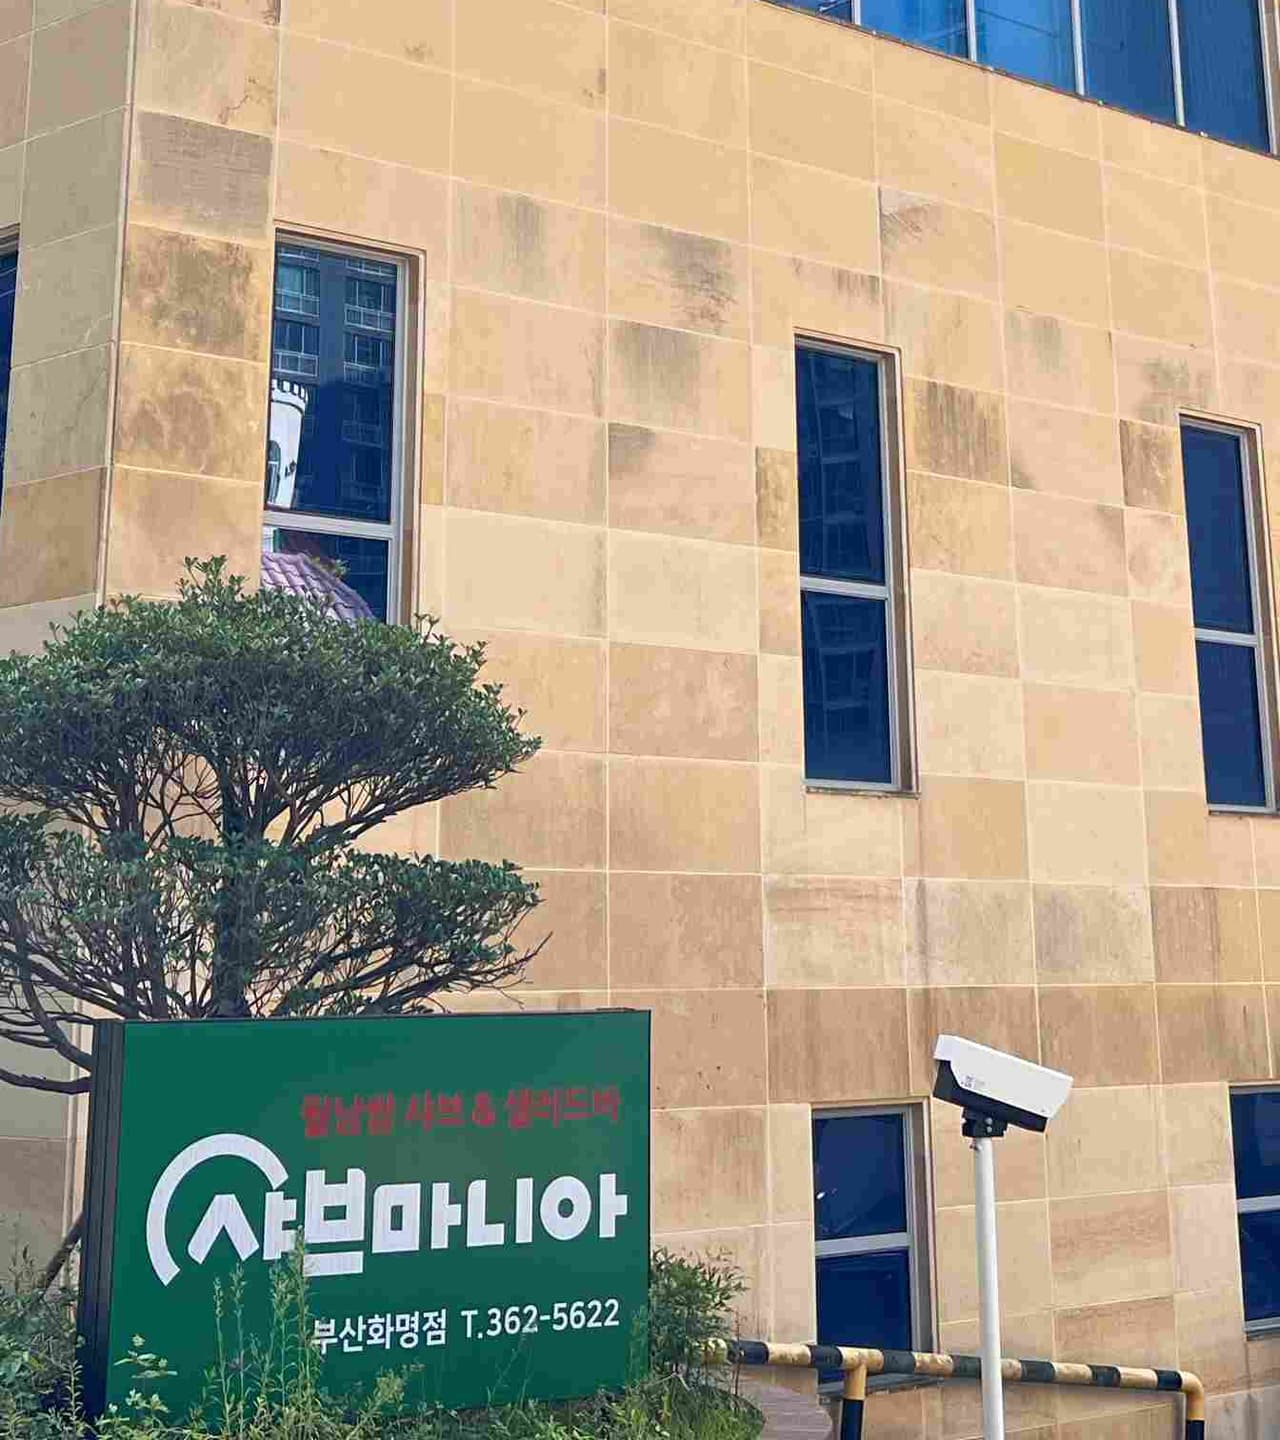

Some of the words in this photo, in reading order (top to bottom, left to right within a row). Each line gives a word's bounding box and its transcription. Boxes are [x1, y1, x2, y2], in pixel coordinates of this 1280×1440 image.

[187, 1167, 628, 1277] 샤브마니아
[311, 1308, 448, 1355] 부산화명점
[460, 1298, 620, 1340] T.362-5622
